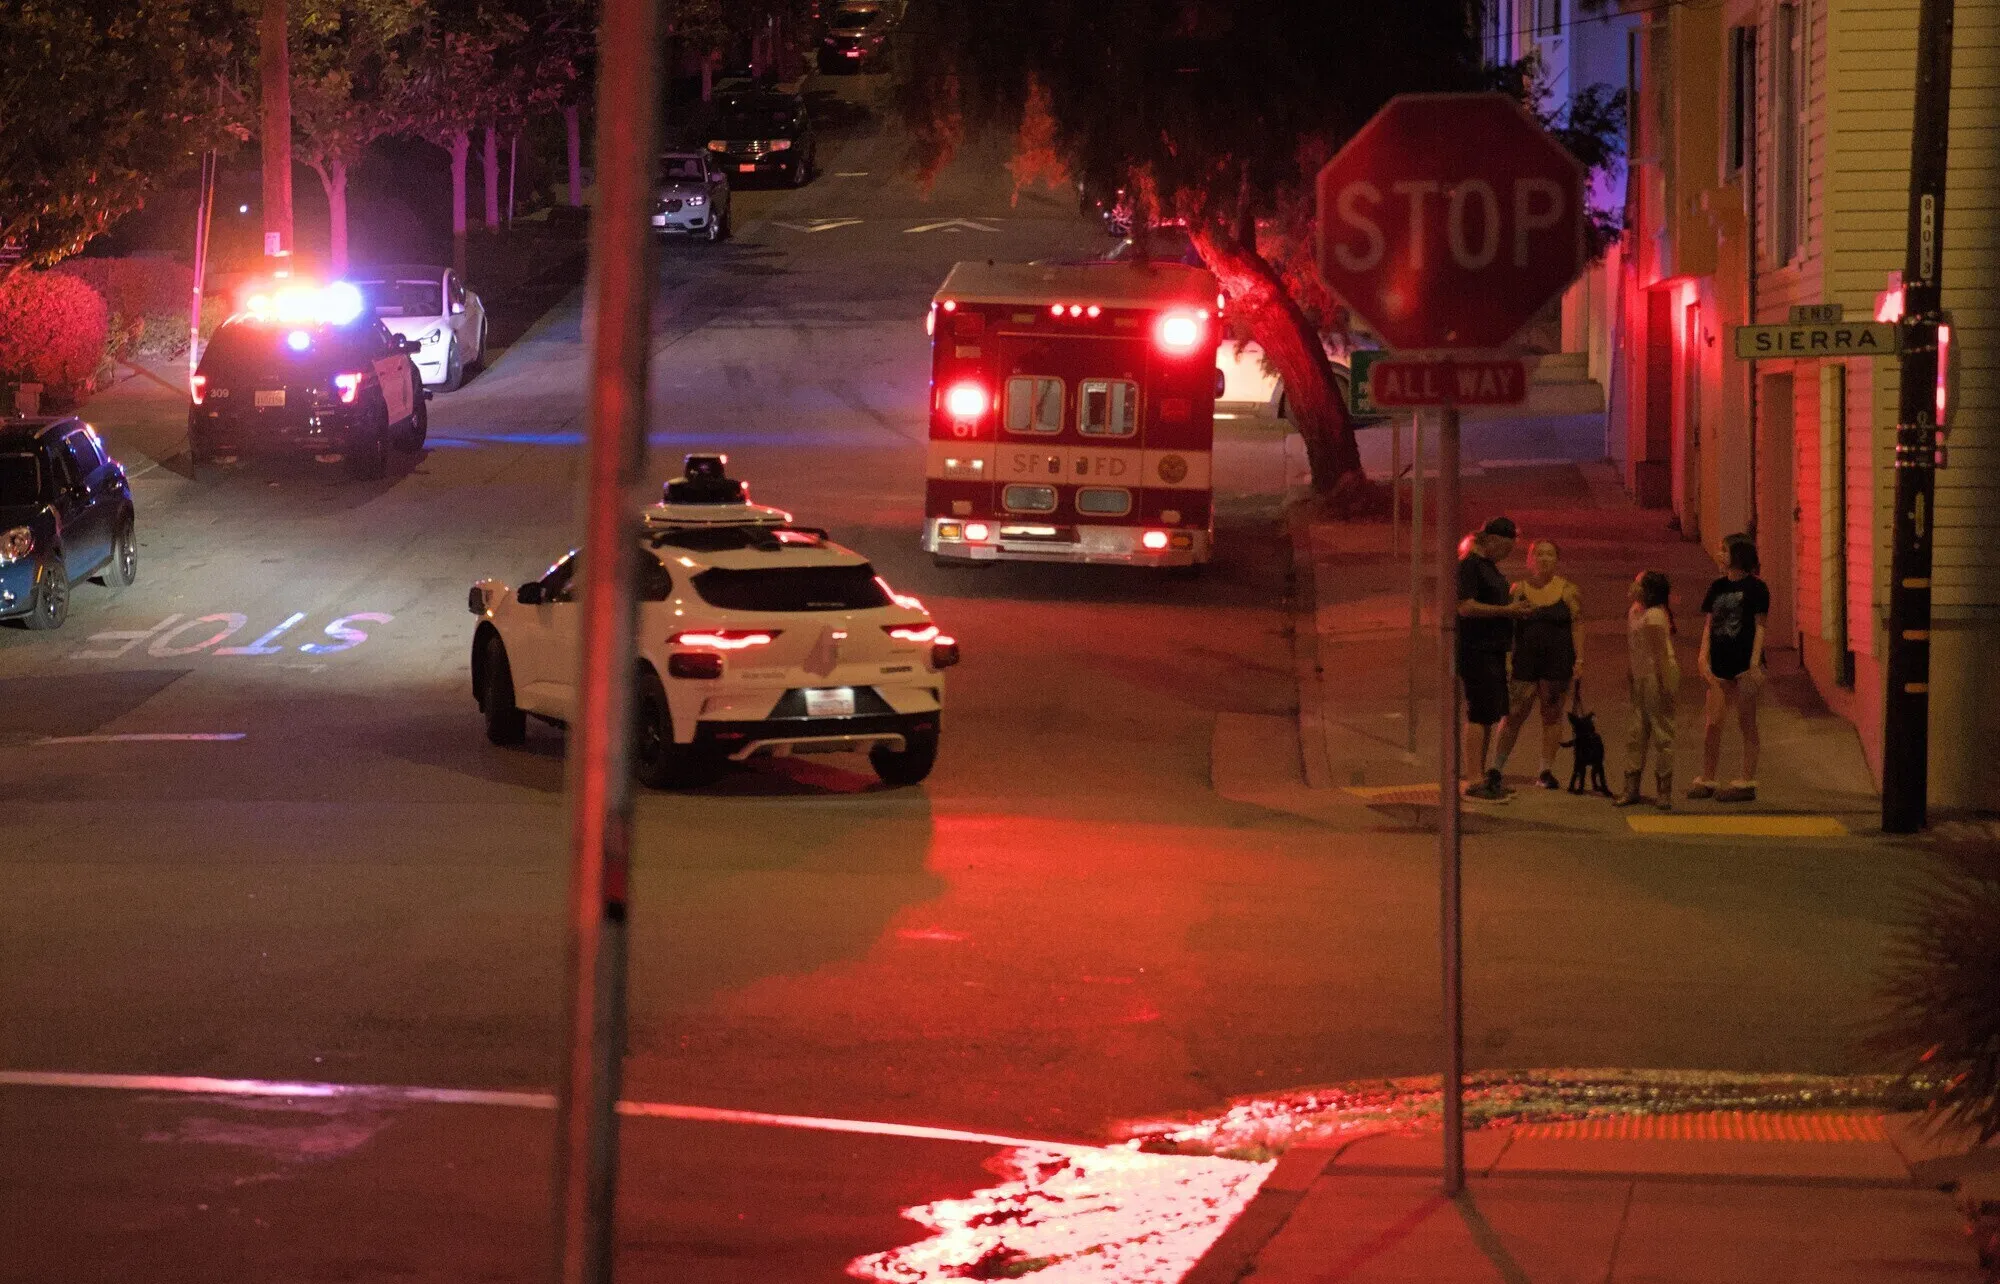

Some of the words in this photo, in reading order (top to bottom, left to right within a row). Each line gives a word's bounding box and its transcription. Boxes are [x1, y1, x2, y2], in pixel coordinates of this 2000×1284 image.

[1335, 178, 1565, 272] STOP
[1799, 306, 1833, 320] END
[1755, 330, 1877, 350] SIERRA
[1385, 369, 1441, 398] ALL
[1457, 368, 1514, 396] WAY
[1013, 454, 1040, 474] SF
[1095, 456, 1127, 476] FD
